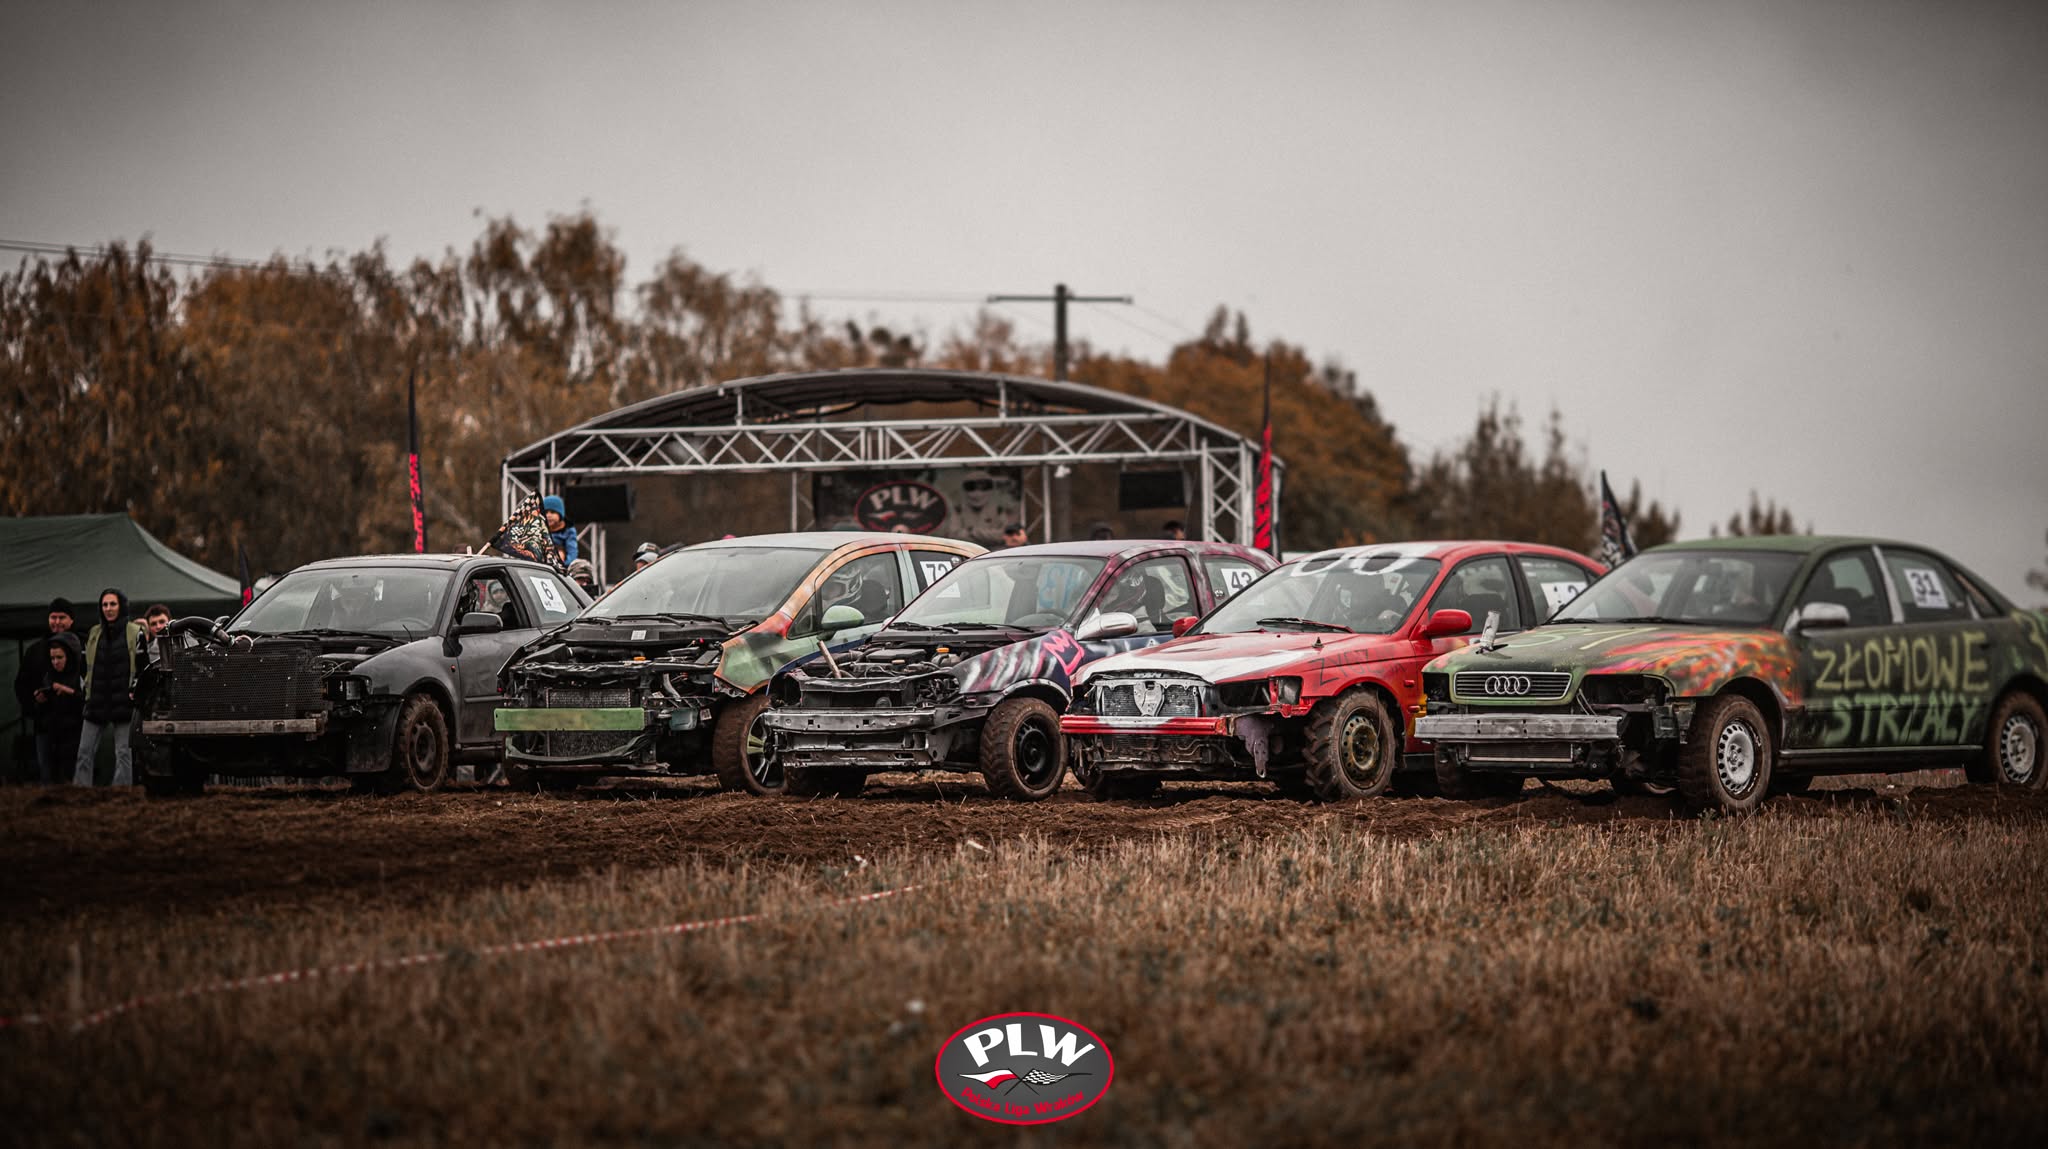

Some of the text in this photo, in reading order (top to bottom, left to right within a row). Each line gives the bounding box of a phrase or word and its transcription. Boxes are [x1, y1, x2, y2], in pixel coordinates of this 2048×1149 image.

[869, 486, 938, 510] PLW
[541, 581, 554, 600] 6
[1911, 572, 1940, 596] 31
[1812, 631, 1989, 692] ZŁOMOWE
